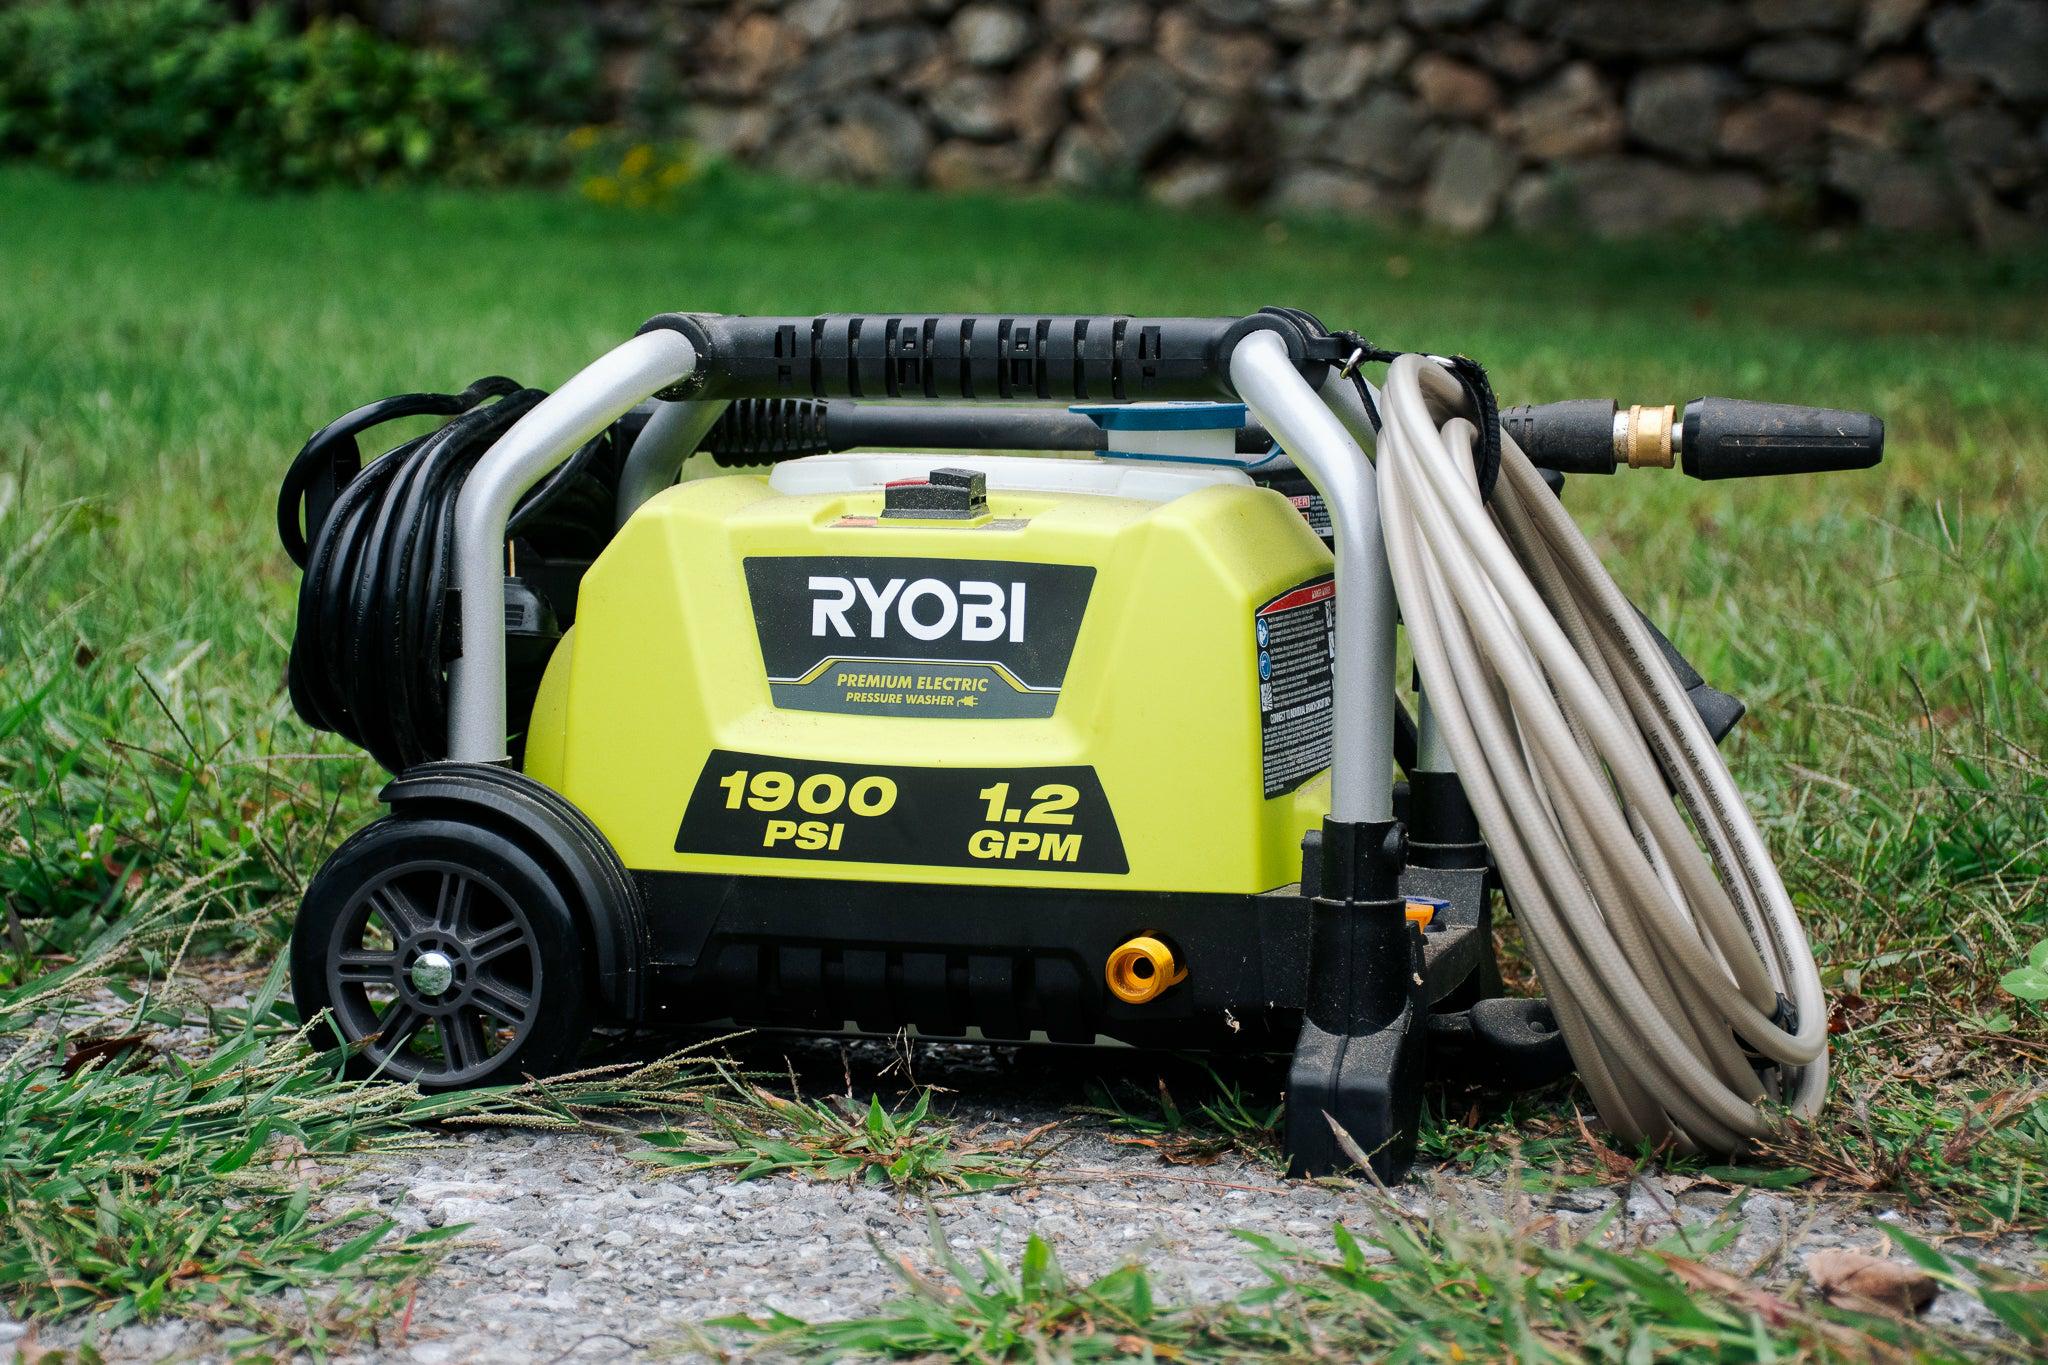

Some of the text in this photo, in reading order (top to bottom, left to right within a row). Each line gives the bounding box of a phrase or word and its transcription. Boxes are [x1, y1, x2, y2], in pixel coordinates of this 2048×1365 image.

[808, 576, 1026, 643] RYOBI
[837, 673, 989, 693] PREMIUM ELECTRIC
[846, 692, 954, 706] PRESSURE WASHER
[1670, 719, 1686, 742] TEMP
[1685, 745, 1700, 768] MAX
[719, 770, 898, 817] 1900
[979, 782, 1080, 826] 1.2
[1698, 768, 1727, 816] SURFACES
[762, 819, 845, 851] PSI
[1724, 817, 1737, 838] HOT
[967, 829, 1083, 862] GPM
[1708, 837, 1723, 862] TEMP
[1734, 839, 1750, 864] FROM
[1721, 864, 1735, 885] MAX
[1748, 866, 1762, 889] AWAY
[1731, 887, 1755, 933] SURFACES
[1760, 892, 1773, 914] KEEP
[1750, 935, 1761, 953] HOT
